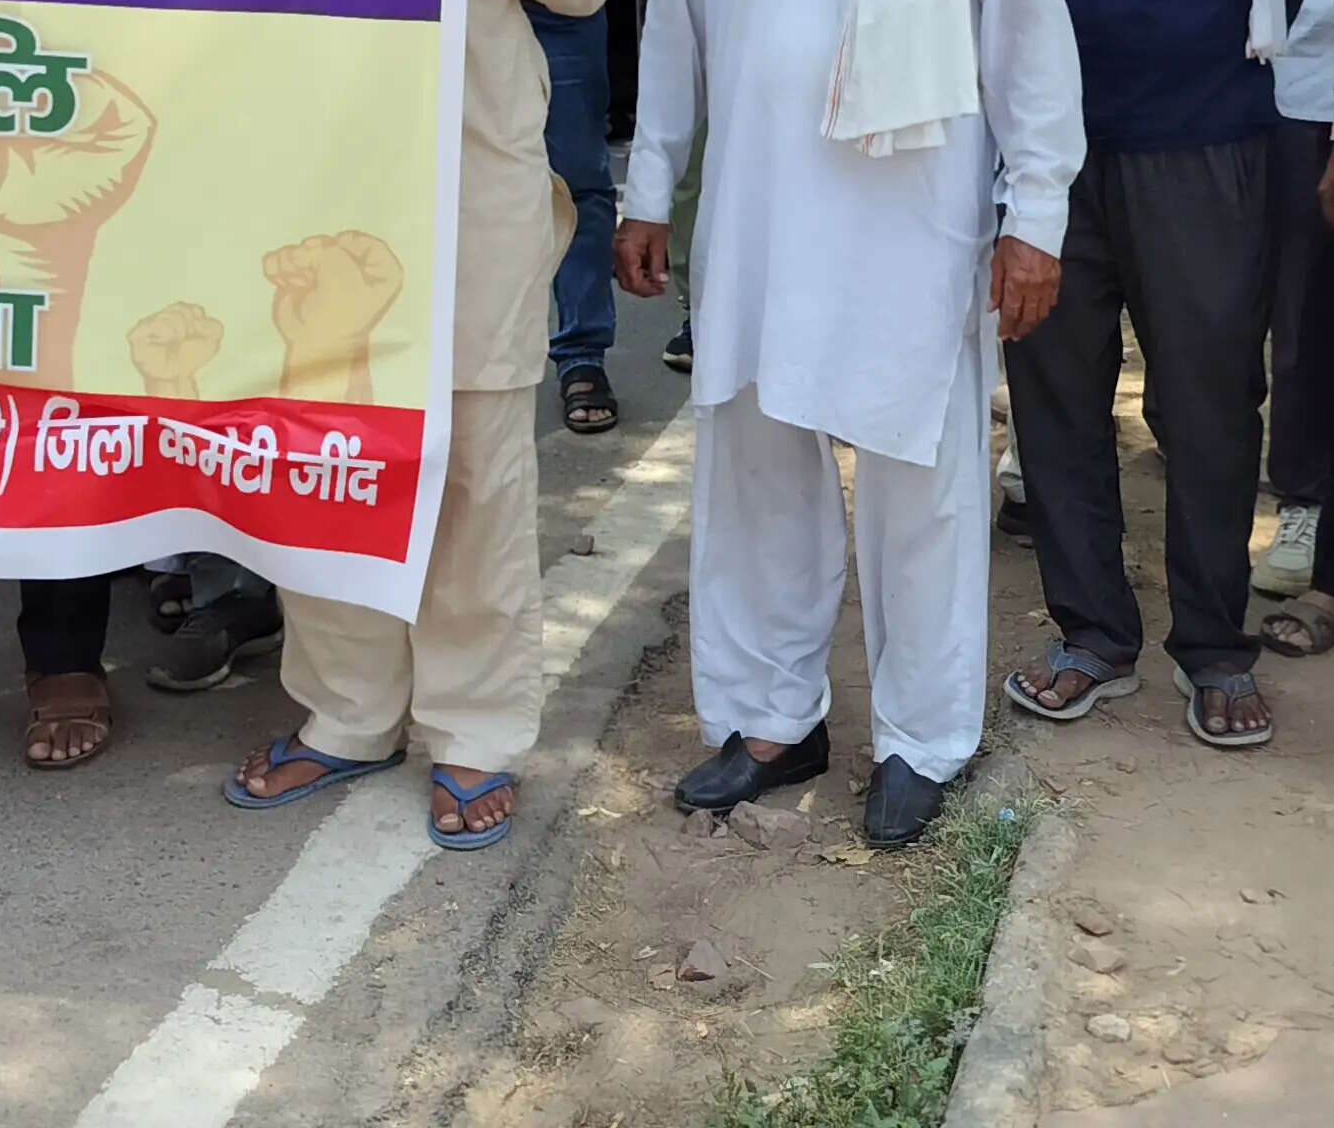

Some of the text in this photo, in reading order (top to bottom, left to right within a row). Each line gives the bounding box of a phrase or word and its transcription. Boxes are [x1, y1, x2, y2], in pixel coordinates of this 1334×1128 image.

[35, 393, 150, 475] जिला
[159, 418, 279, 493] कमेटी
[288, 432, 385, 505] जींद
